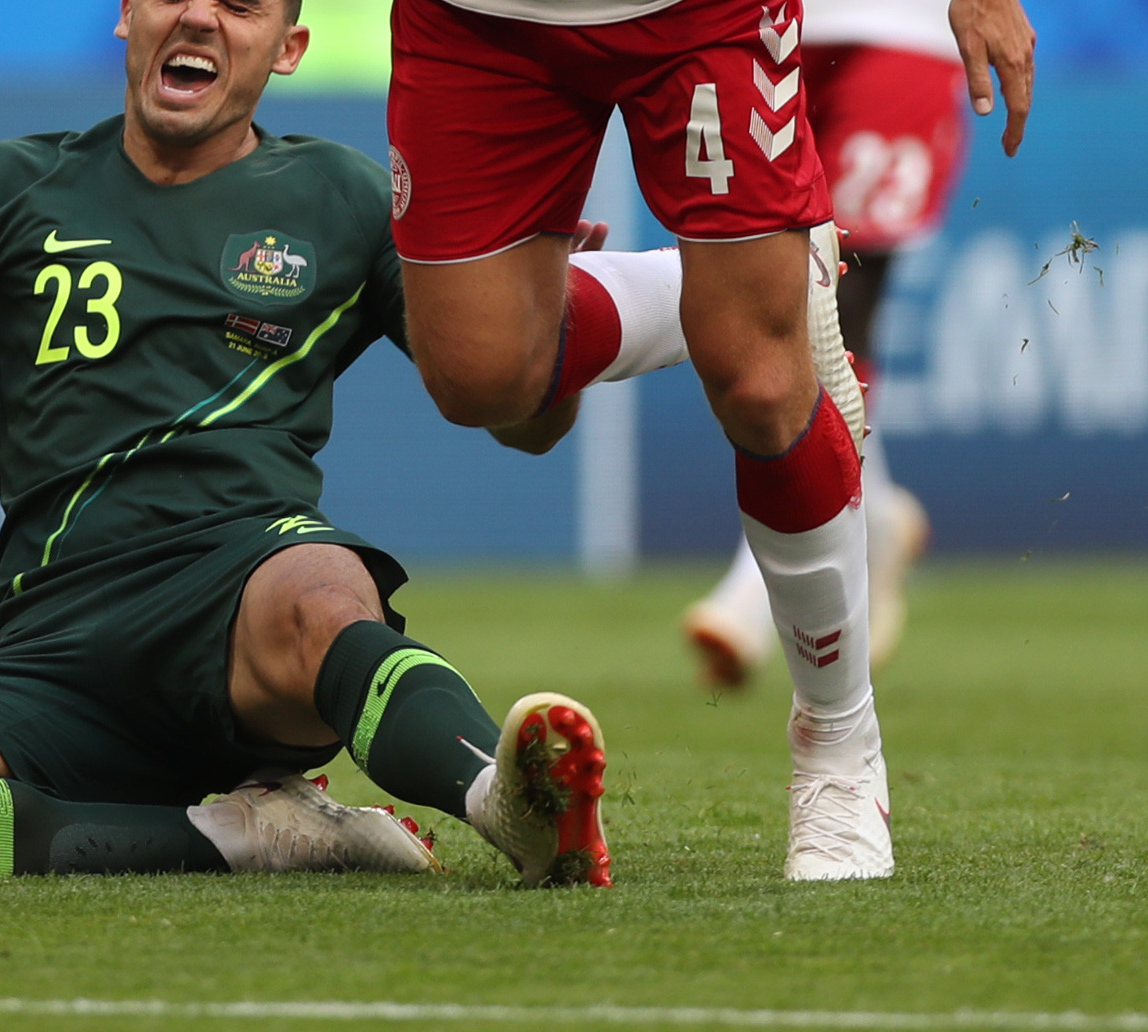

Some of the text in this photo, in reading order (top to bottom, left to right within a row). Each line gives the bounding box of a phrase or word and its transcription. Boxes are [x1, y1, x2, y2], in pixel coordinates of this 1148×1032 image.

[685, 82, 735, 195] 4
[34, 261, 123, 366] 23
[237, 272, 297, 287] AUSTRALIA
